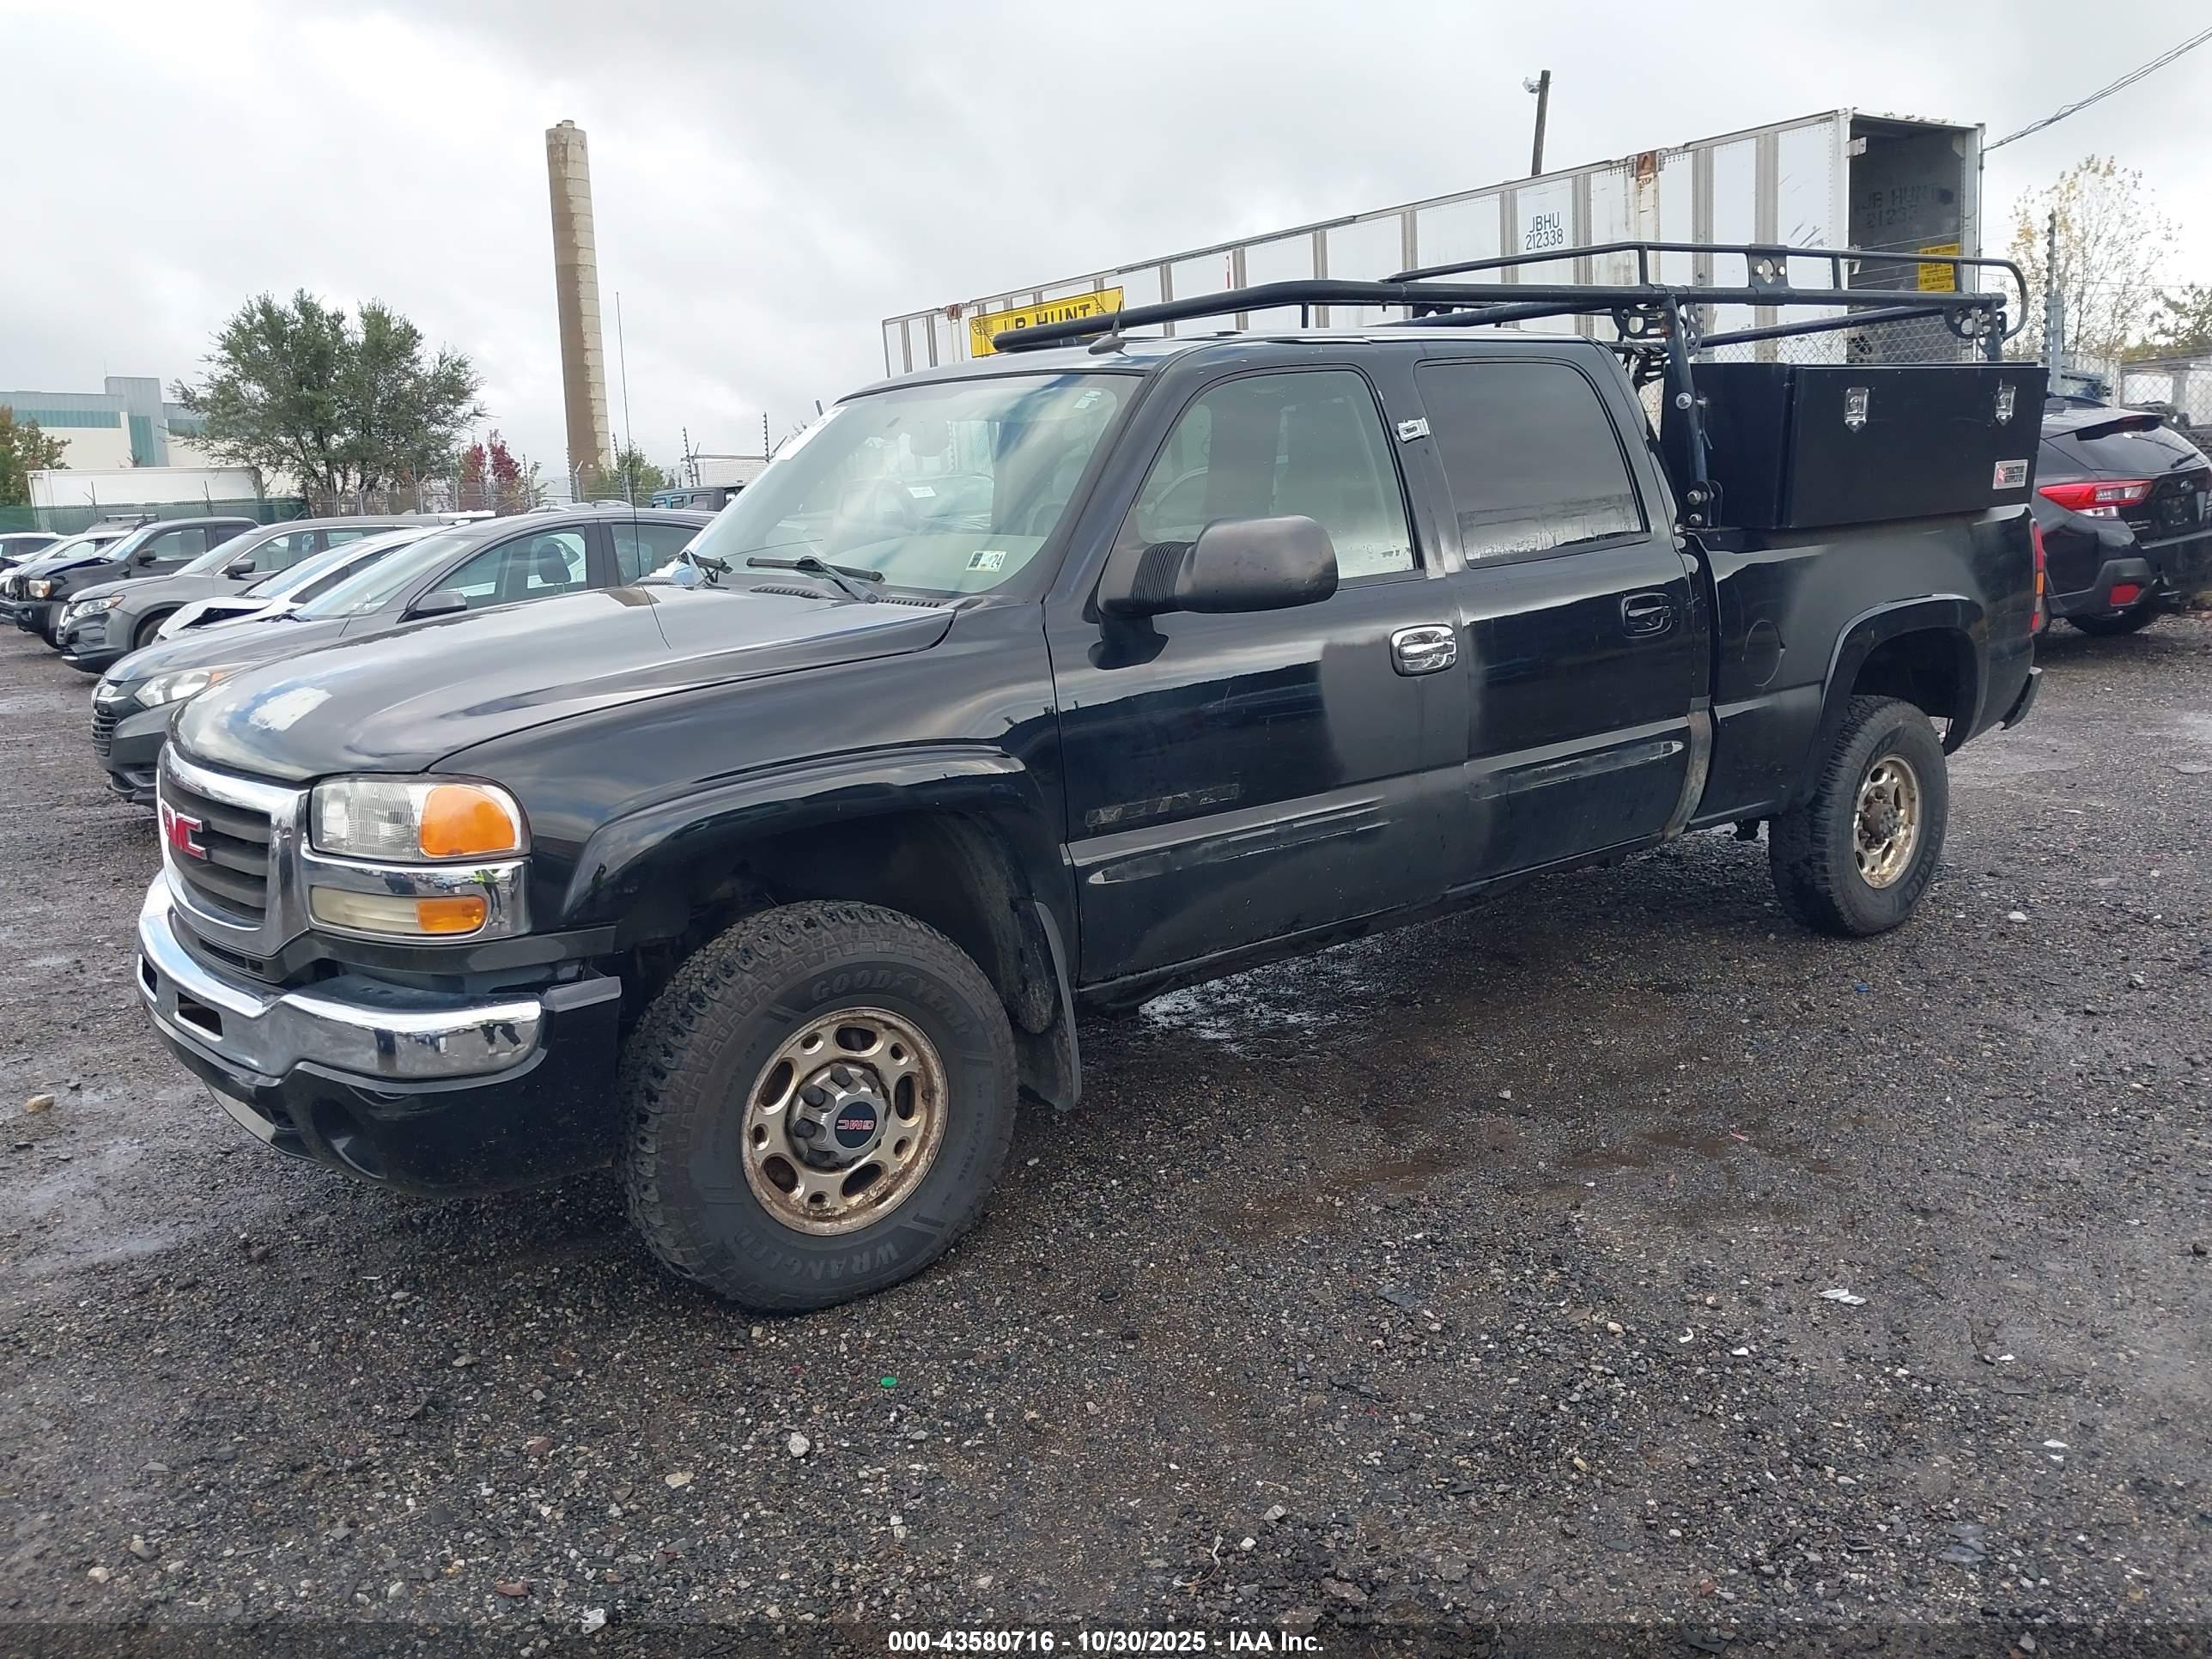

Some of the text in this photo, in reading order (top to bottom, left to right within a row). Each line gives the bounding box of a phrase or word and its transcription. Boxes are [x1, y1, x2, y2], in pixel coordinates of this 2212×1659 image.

[1529, 211, 1560, 233] JBHU
[1525, 228, 1564, 250] 212338
[812, 969, 969, 1034] GOODYEAR
[836, 1119, 875, 1130] GMC
[733, 1227, 900, 1280] WRANGLER
